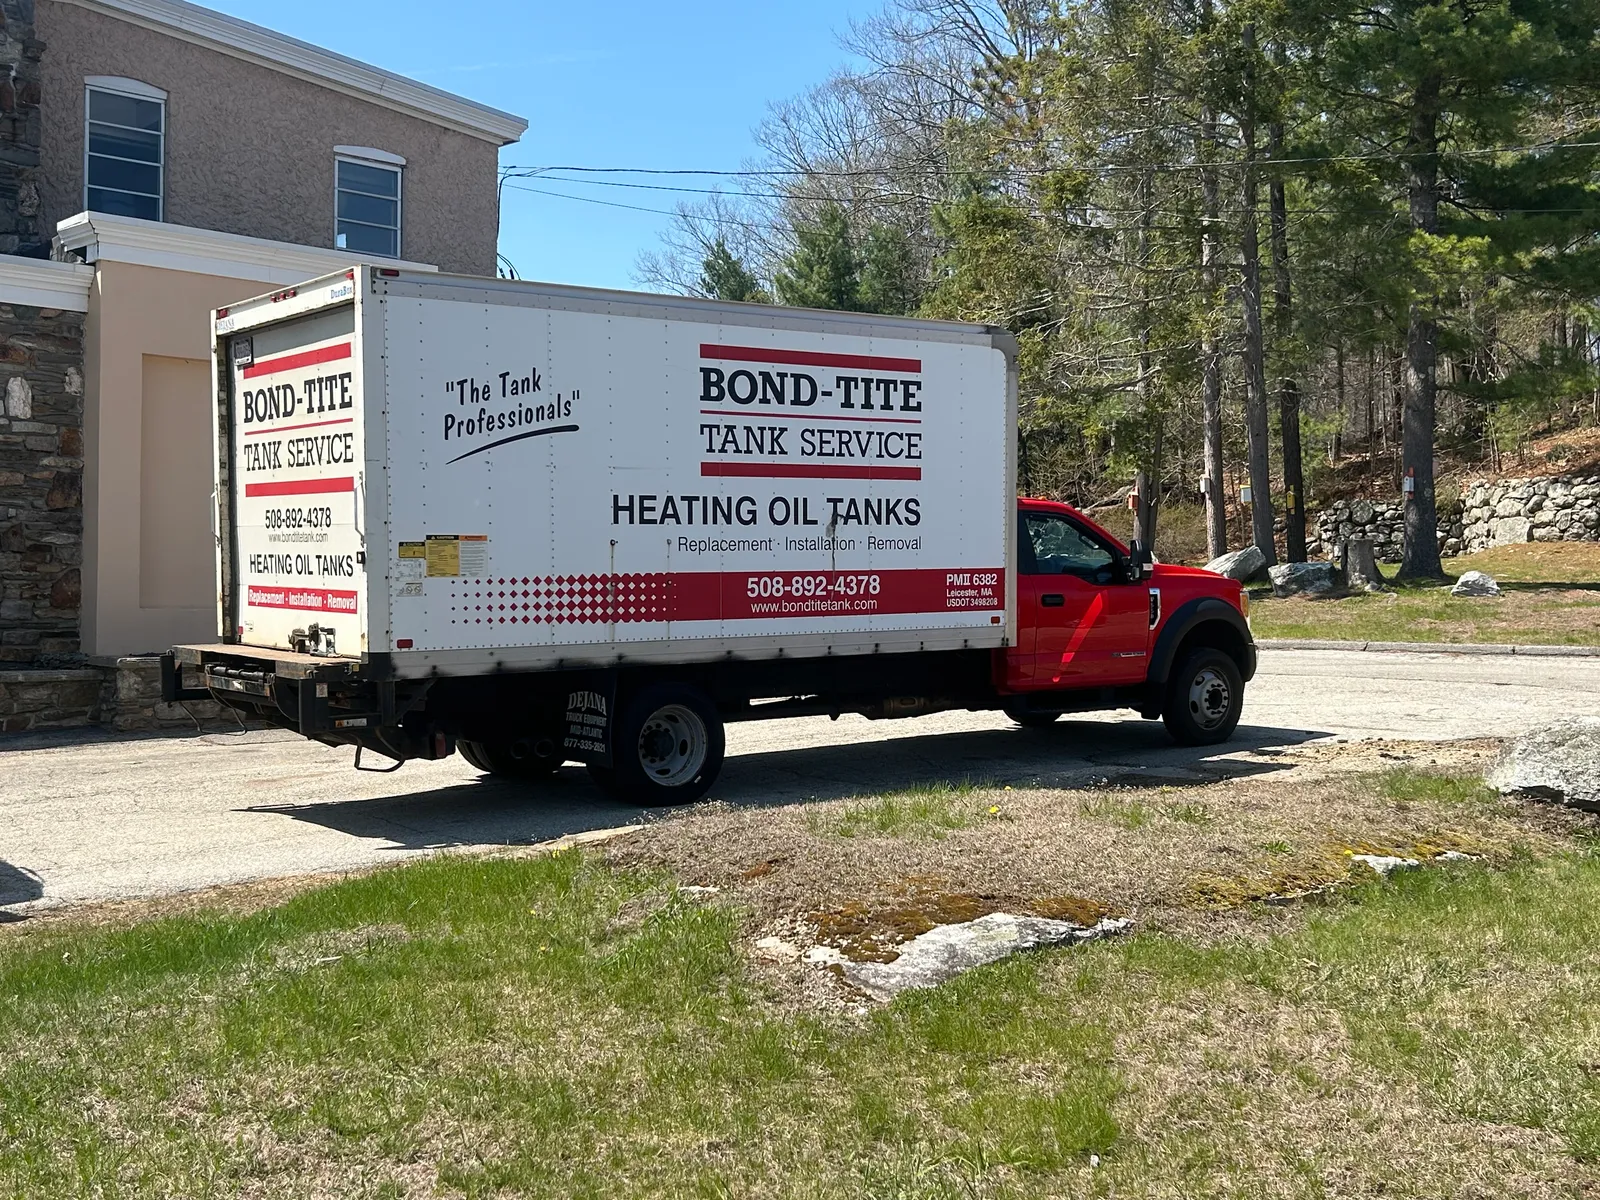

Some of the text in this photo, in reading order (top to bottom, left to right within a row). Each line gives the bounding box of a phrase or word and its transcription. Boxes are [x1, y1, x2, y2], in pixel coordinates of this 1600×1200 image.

[243, 371, 353, 423] BOND-TITE
[446, 367, 541, 406] "The Tank
[699, 367, 922, 412] BOND-TITE
[444, 389, 580, 441] Professionals"
[244, 432, 354, 471] TANK SERVICE
[699, 423, 922, 459] TANK SERVICE
[265, 507, 332, 529] 508-892-4378
[612, 494, 921, 526] HEATING OIL TANKS
[268, 531, 329, 543] www.bondtitetank.com
[678, 536, 922, 555] Replacement Installation Removal
[250, 554, 354, 577] HEATING OIL TANKS
[746, 575, 881, 598] 508-892-4378
[973, 573, 998, 586] 6382
[249, 589, 357, 610] Replacement Installation Removal
[946, 587, 993, 597] Leicester, MA
[946, 597, 998, 607] USDOT 3498208
[750, 598, 878, 613] www.bondtitetank.com
[567, 691, 607, 716] DEJANA
[566, 711, 607, 727] TRUCK EQUIPMENT
